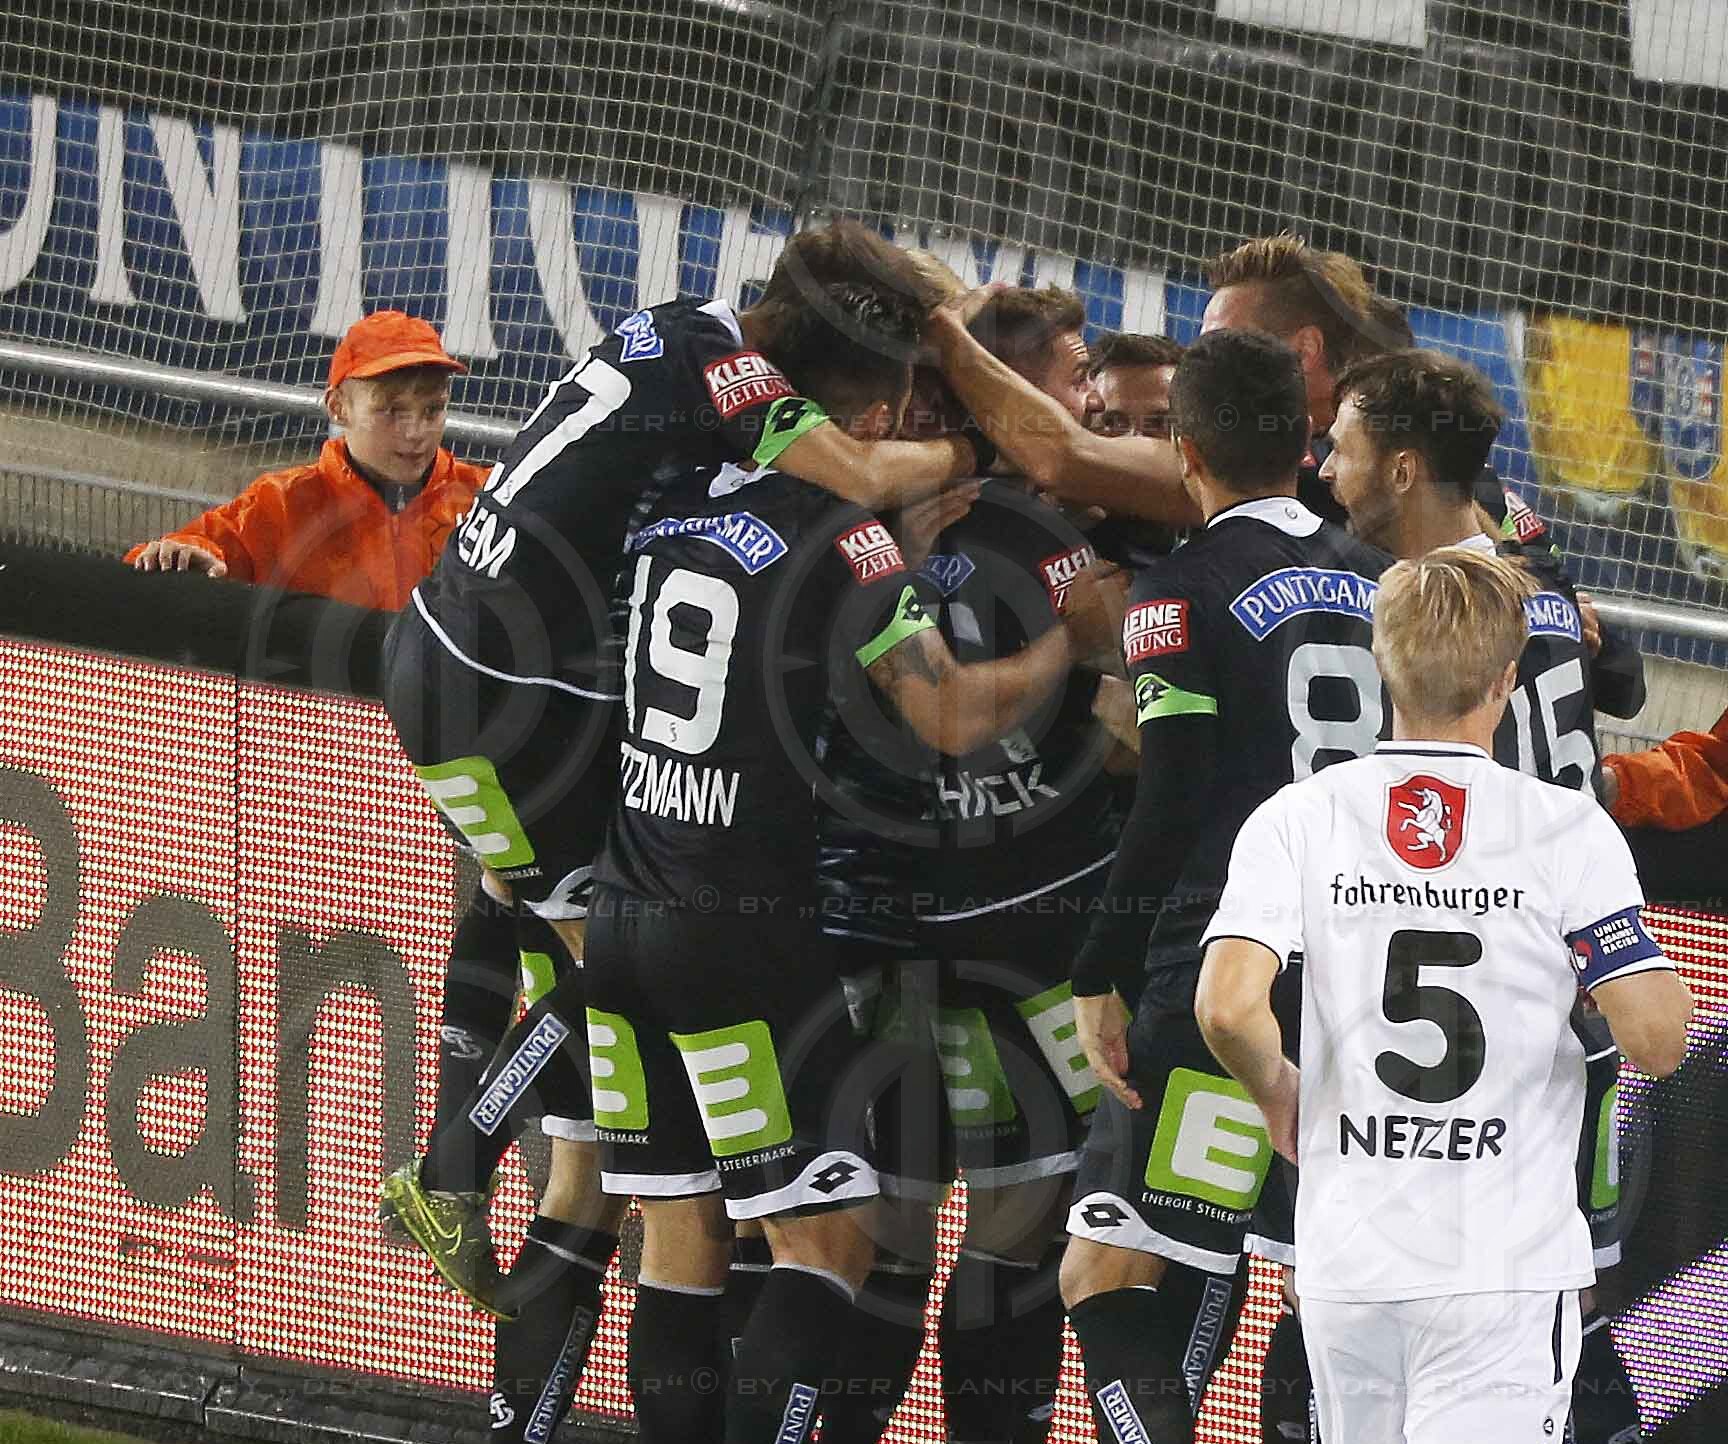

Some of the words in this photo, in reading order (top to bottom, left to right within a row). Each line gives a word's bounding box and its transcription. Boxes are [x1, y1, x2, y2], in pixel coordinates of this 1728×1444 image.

[624, 554, 740, 755] 19
[1287, 643, 1384, 785] 8
[1510, 658, 1597, 802] 15
[1593, 917, 1631, 938] UNITE
[1374, 929, 1486, 1104] 5
[1340, 1113, 1507, 1161] NETZER
